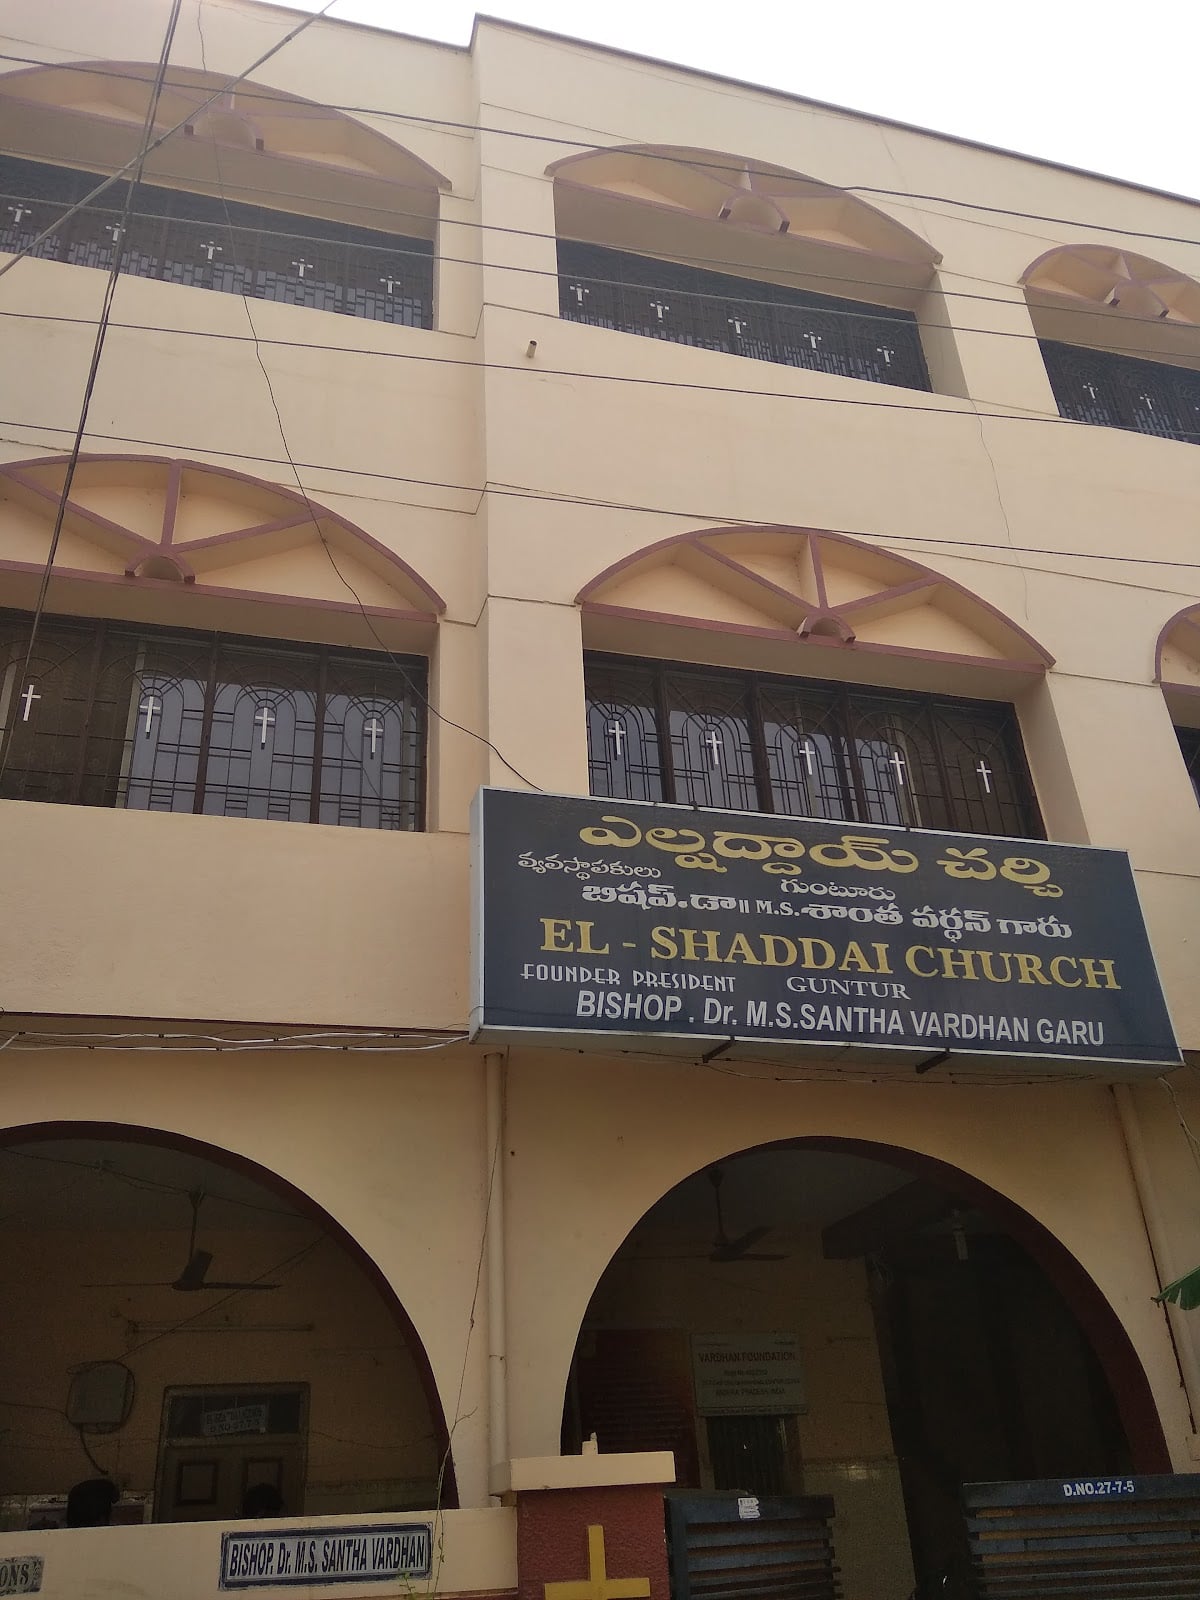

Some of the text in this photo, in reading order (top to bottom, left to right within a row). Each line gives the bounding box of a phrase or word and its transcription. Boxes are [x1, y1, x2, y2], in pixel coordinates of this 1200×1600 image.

[517, 851, 662, 881] వ్యవస్థాపకులు
[936, 847, 1064, 898] చర్చి
[780, 878, 896, 901] గుంటూరు
[910, 905, 992, 942] వర్ధన్
[996, 914, 1073, 939] గారు
[539, 917, 610, 955] EL
[650, 925, 894, 975] SHADDAI
[904, 944, 1122, 990] CHURCH
[520, 963, 737, 993] FOUNDER PRESIDENT
[786, 976, 912, 1000] GUNTUR
[703, 997, 738, 1026] Dr.
[910, 1009, 1030, 1043] VARDHAN
[1036, 1018, 1105, 1046] GARU
[1062, 1480, 1135, 1497] D.NO.27-7-5
[229, 1535, 425, 1577] BISHOP. Dr. M.S. SANTHA VARDHAN
